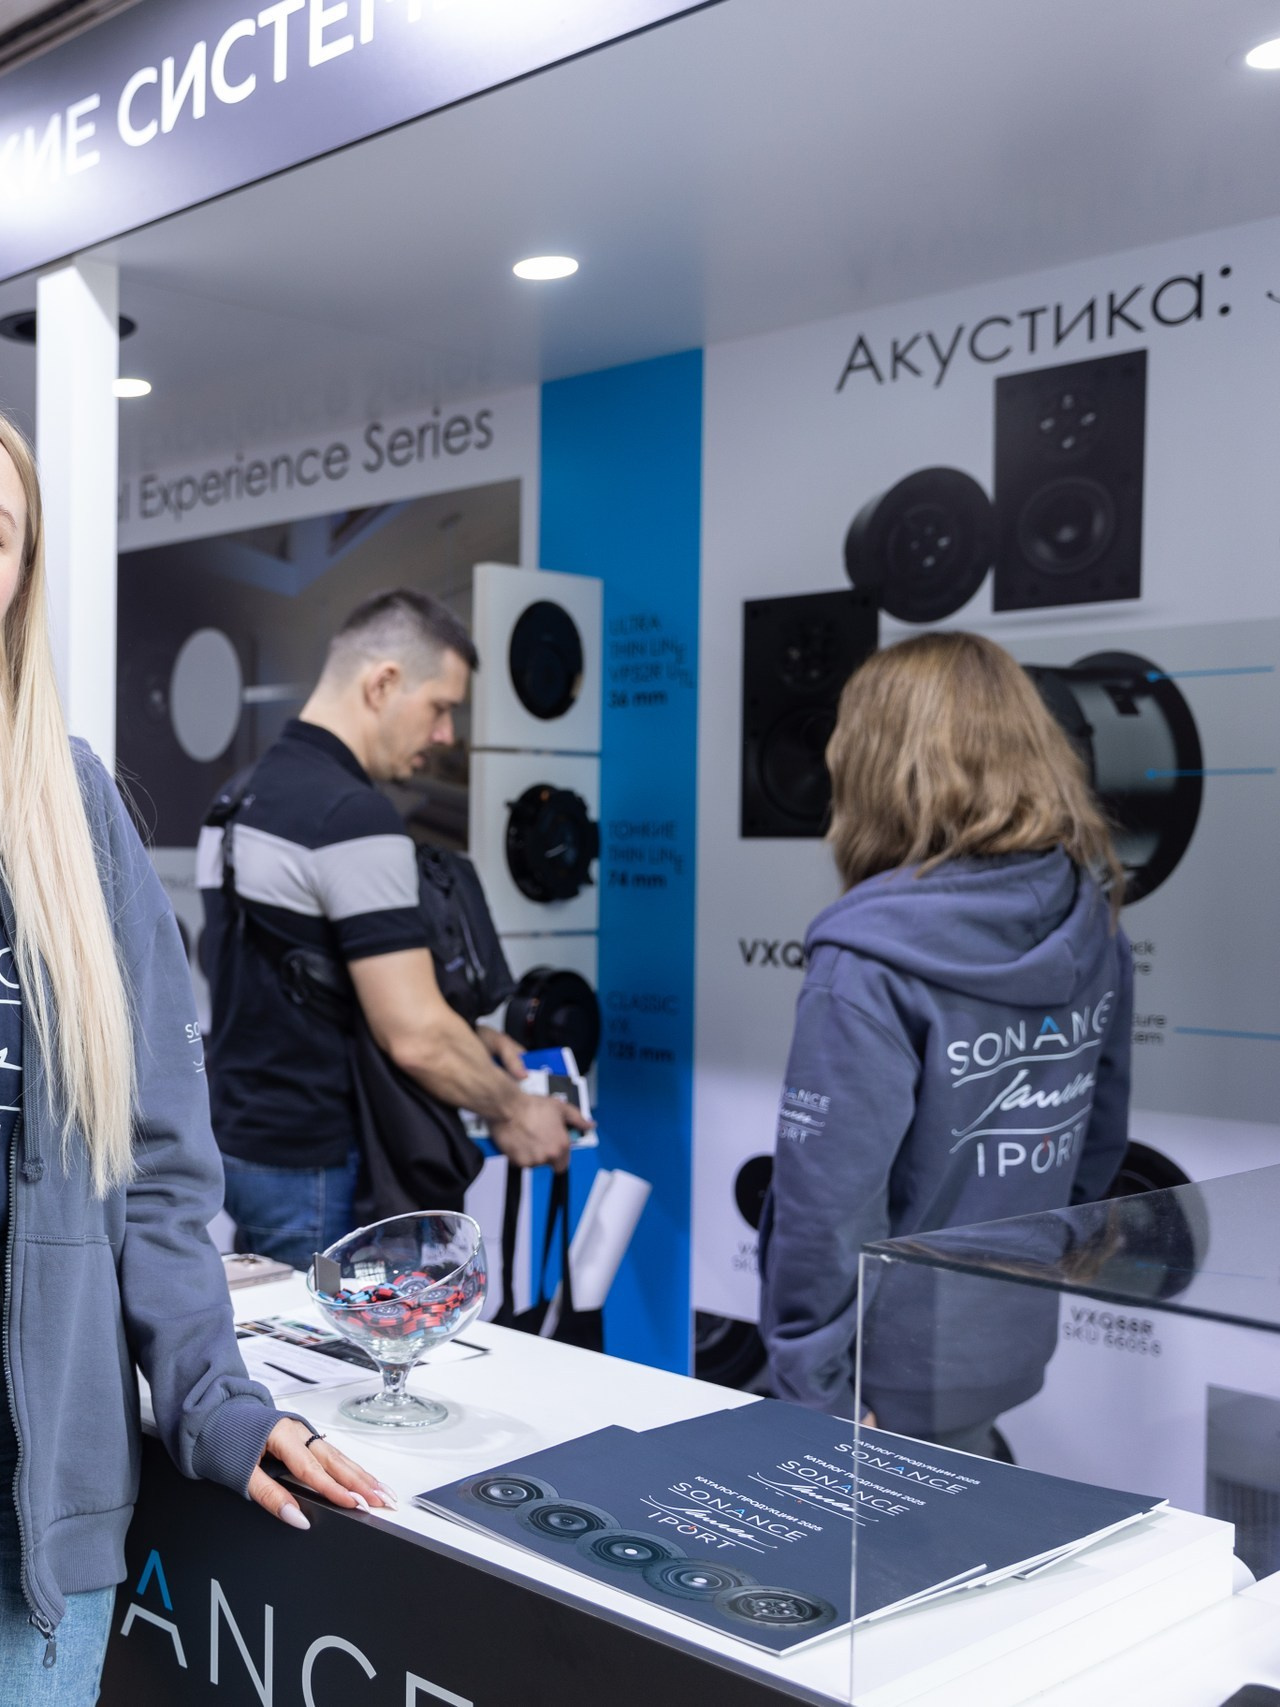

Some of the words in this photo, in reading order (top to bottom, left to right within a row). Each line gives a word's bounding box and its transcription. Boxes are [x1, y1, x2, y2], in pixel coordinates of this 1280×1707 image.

[835, 264, 1233, 394] Акустика:
[138, 441, 350, 523] Experience
[363, 406, 494, 474] Series
[781, 1460, 910, 1515] SONANCE
[803, 1454, 847, 1474] КАТАЛОГ
[845, 1471, 902, 1498] ПРОДУКЦИИ
[901, 1495, 926, 1506] 2025
[834, 1443, 968, 1494] SONANCE
[853, 1439, 895, 1457] КАТАЛОГ
[894, 1454, 955, 1479] ПРОДУКЦИИ
[954, 1475, 981, 1485] 2025
[647, 1511, 736, 1549] IPORT
[672, 1481, 808, 1542] SONANCE
[694, 1475, 740, 1497] КАТАЛОГ
[737, 1494, 799, 1524] ПРОДУКЦИИ
[797, 1519, 824, 1532] 2025
